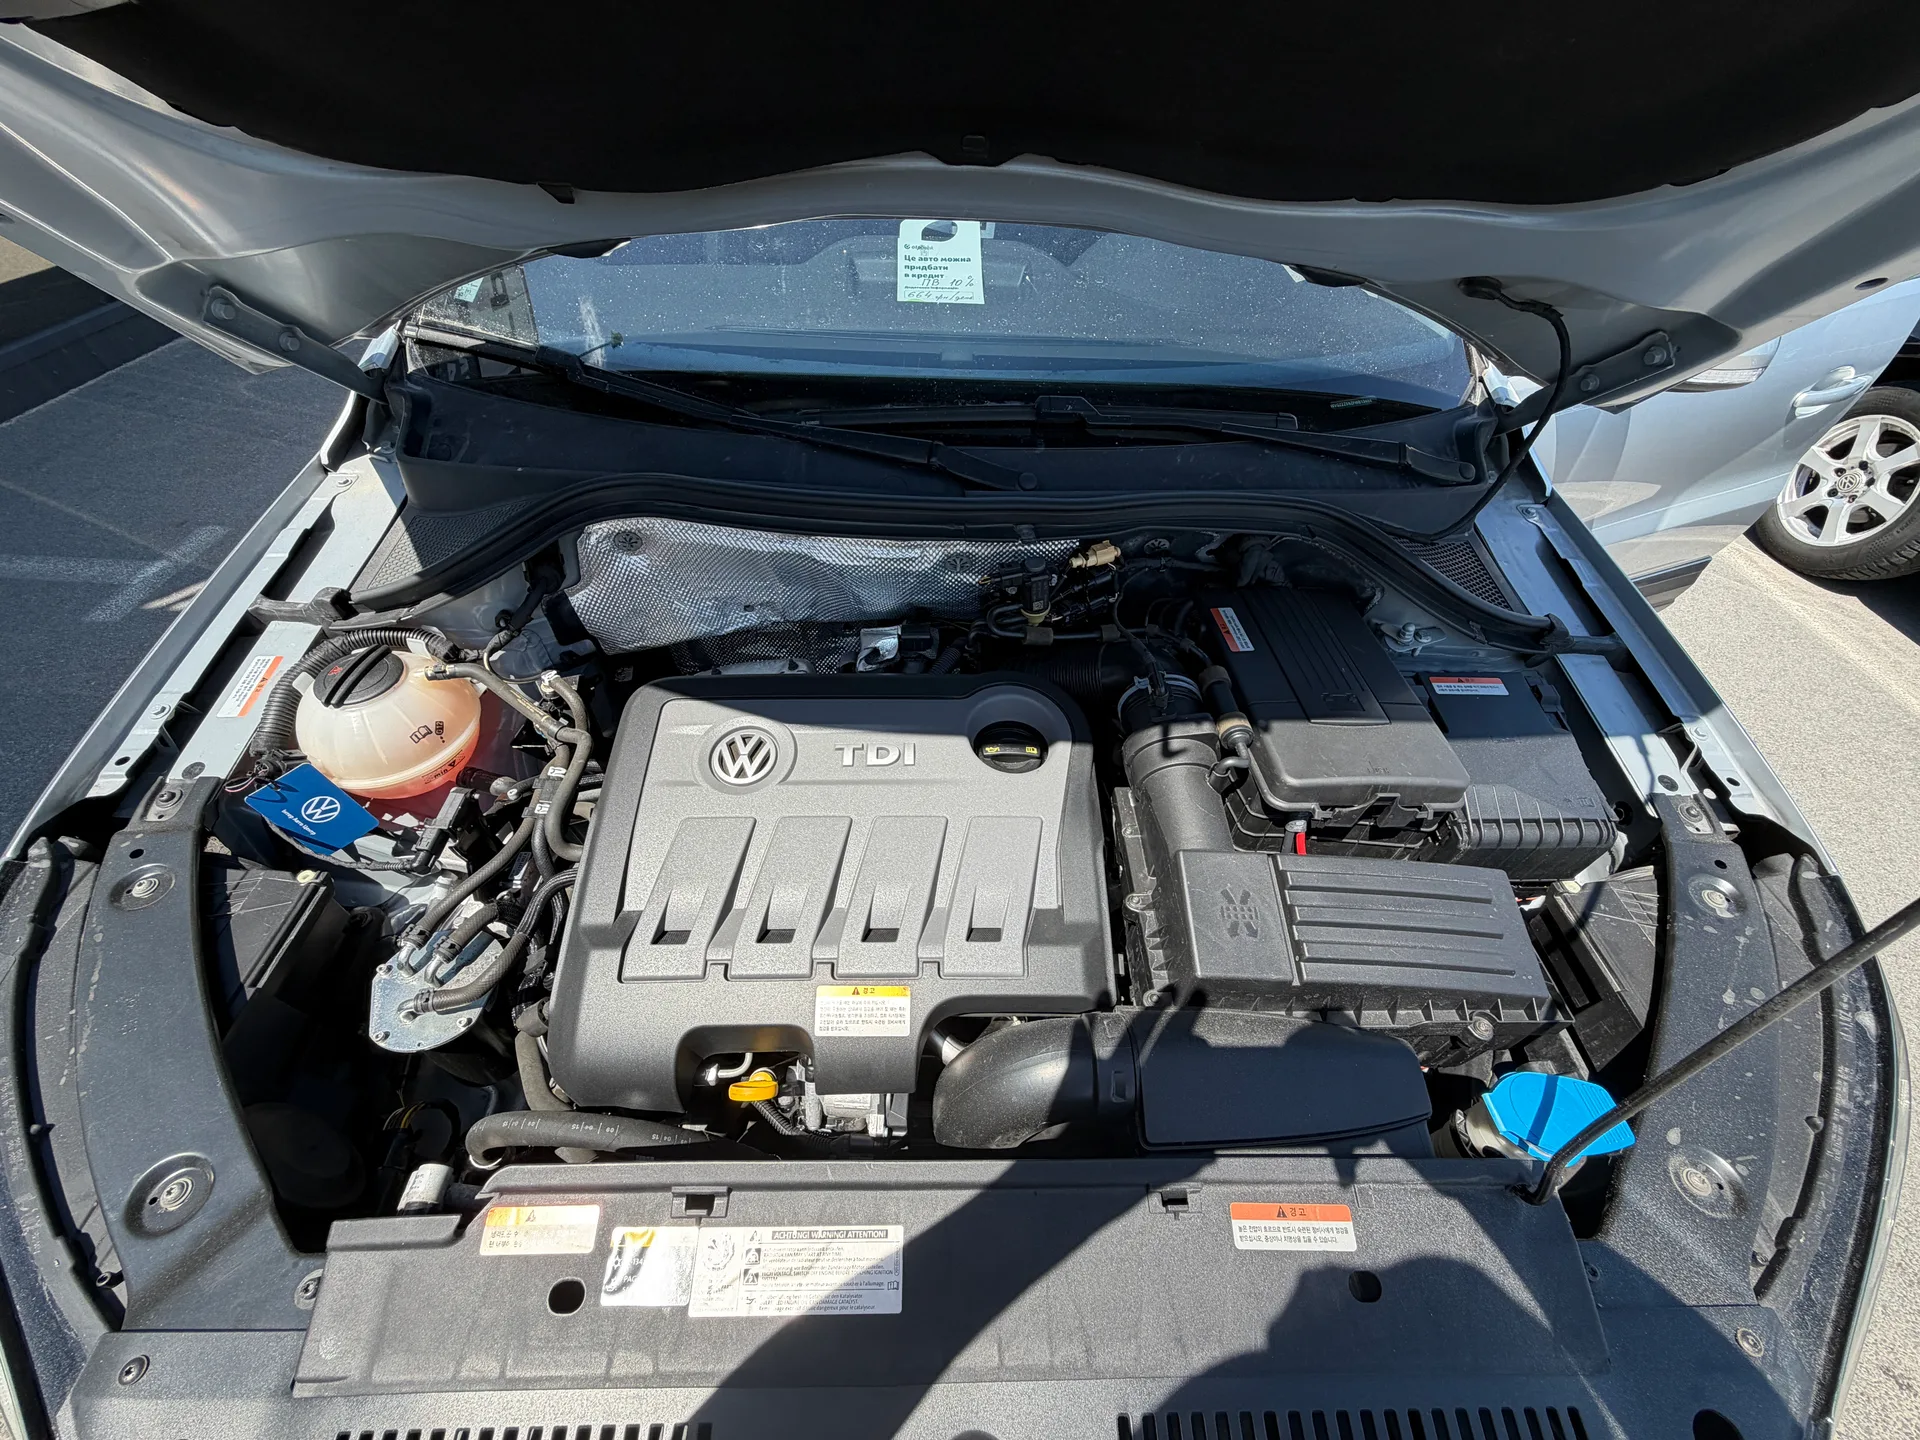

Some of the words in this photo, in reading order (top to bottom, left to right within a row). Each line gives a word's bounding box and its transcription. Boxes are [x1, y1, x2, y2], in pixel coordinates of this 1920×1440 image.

[904, 254, 916, 262] Це
[904, 264, 948, 272] придбати
[435, 721, 444, 735] G12
[834, 742, 916, 767] TDI
[434, 768, 448, 778] min
[1289, 1207, 1307, 1216] 경고
[774, 1230, 809, 1240] ACHTUNG!
[811, 1230, 847, 1239] WARNING!
[847, 1230, 887, 1238] ATTENTION!
